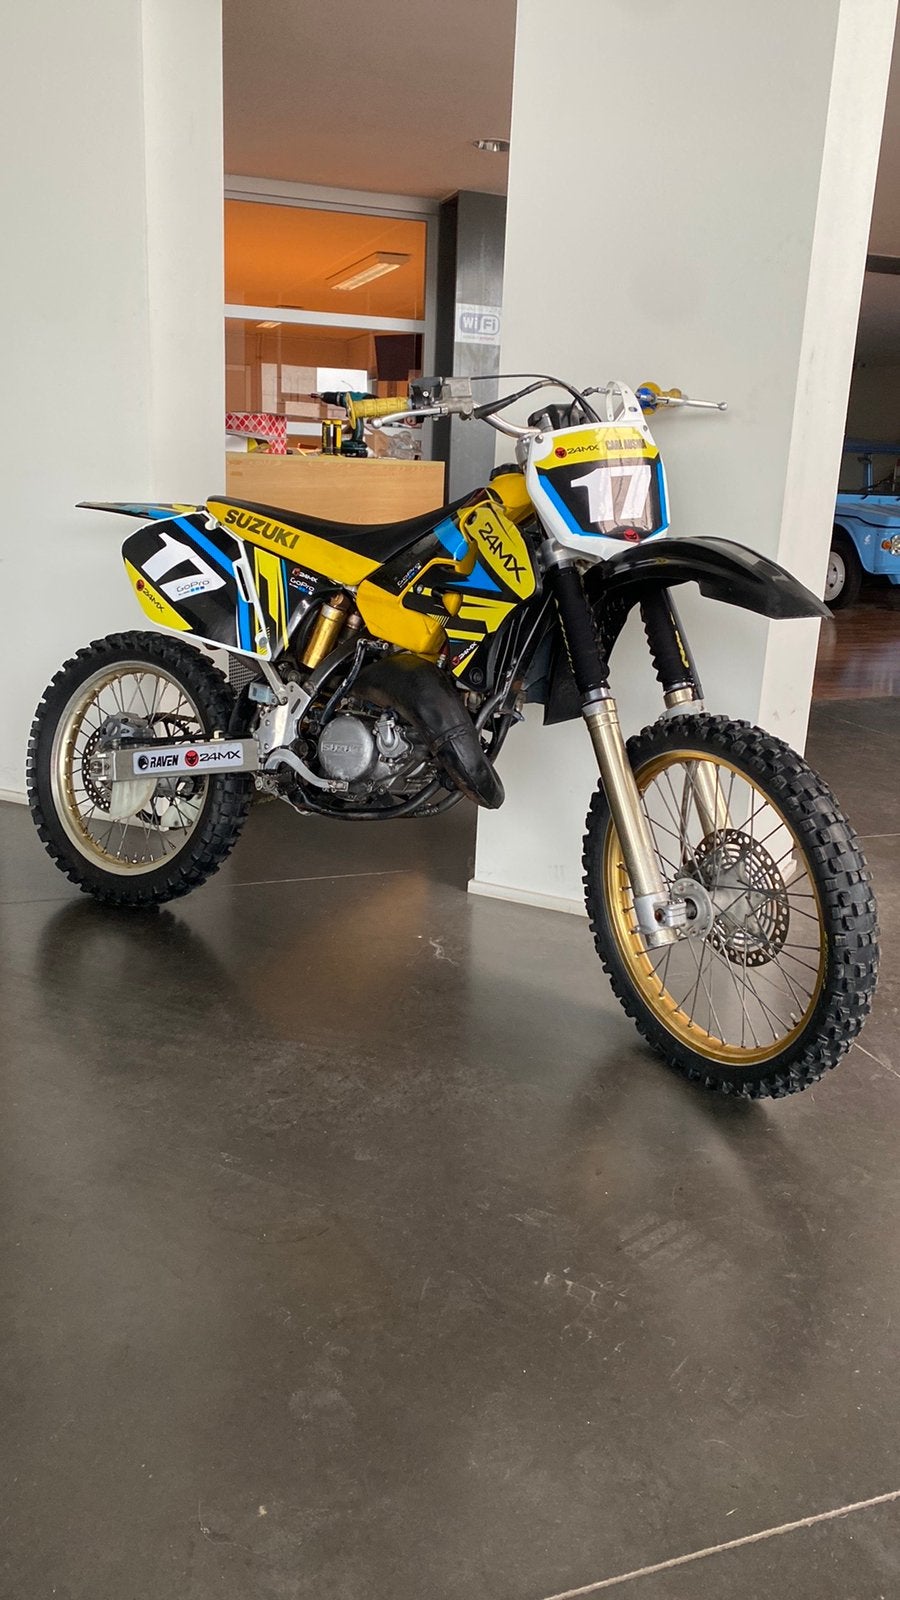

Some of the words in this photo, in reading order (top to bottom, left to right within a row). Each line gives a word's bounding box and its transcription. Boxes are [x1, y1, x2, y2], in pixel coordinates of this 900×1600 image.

[566, 444, 600, 454] 24MX
[570, 465, 652, 523] 17
[224, 509, 300, 549] SUZUKI
[478, 522, 526, 584] 24MX
[176, 580, 210, 592] GoPro
[290, 577, 315, 592] GoPro
[142, 588, 165, 612] 24MX
[150, 754, 180, 768] RAVEN
[199, 750, 241, 762] 24MX
